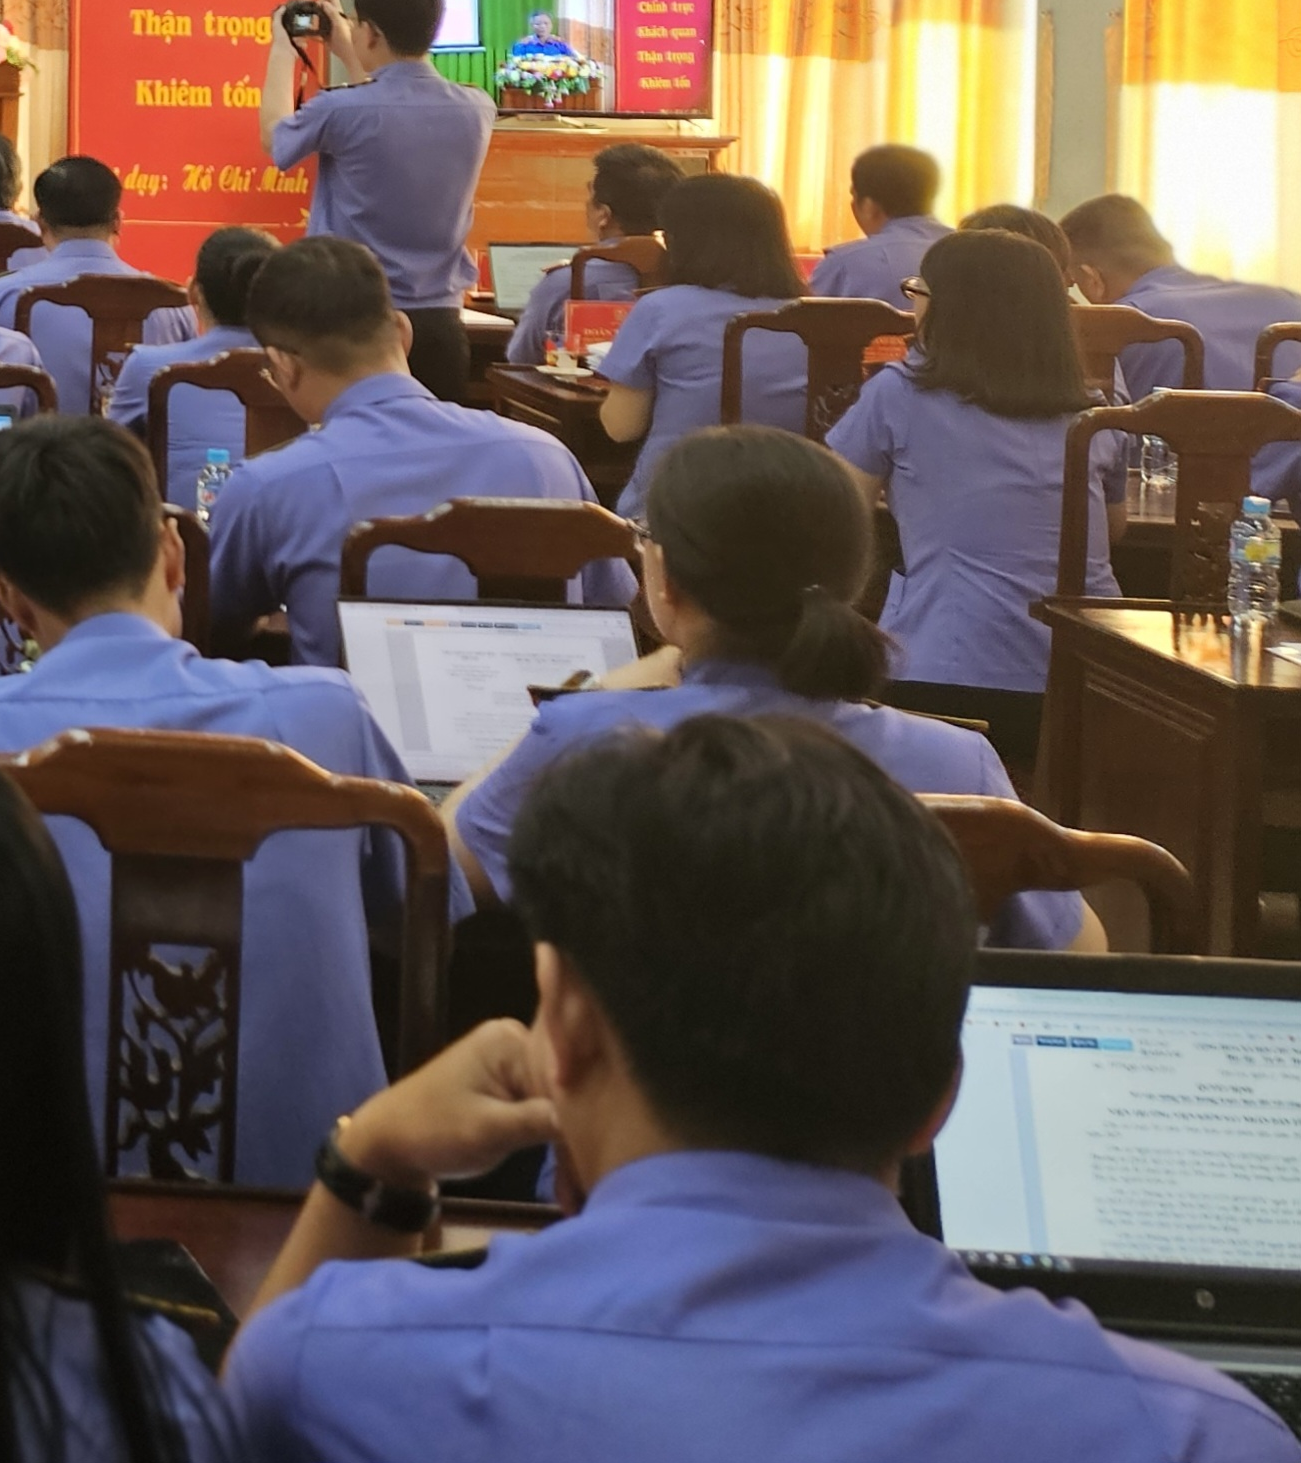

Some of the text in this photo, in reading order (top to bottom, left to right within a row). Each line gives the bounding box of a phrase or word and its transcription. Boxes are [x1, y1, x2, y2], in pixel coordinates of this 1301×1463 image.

[130, 8, 273, 46] Thận trọng
[135, 74, 262, 108] Khiêm tốn
[123, 164, 168, 197] dạy:
[182, 163, 214, 192] Hồ
[218, 164, 257, 193] Chí
[256, 165, 309, 194] Minh
